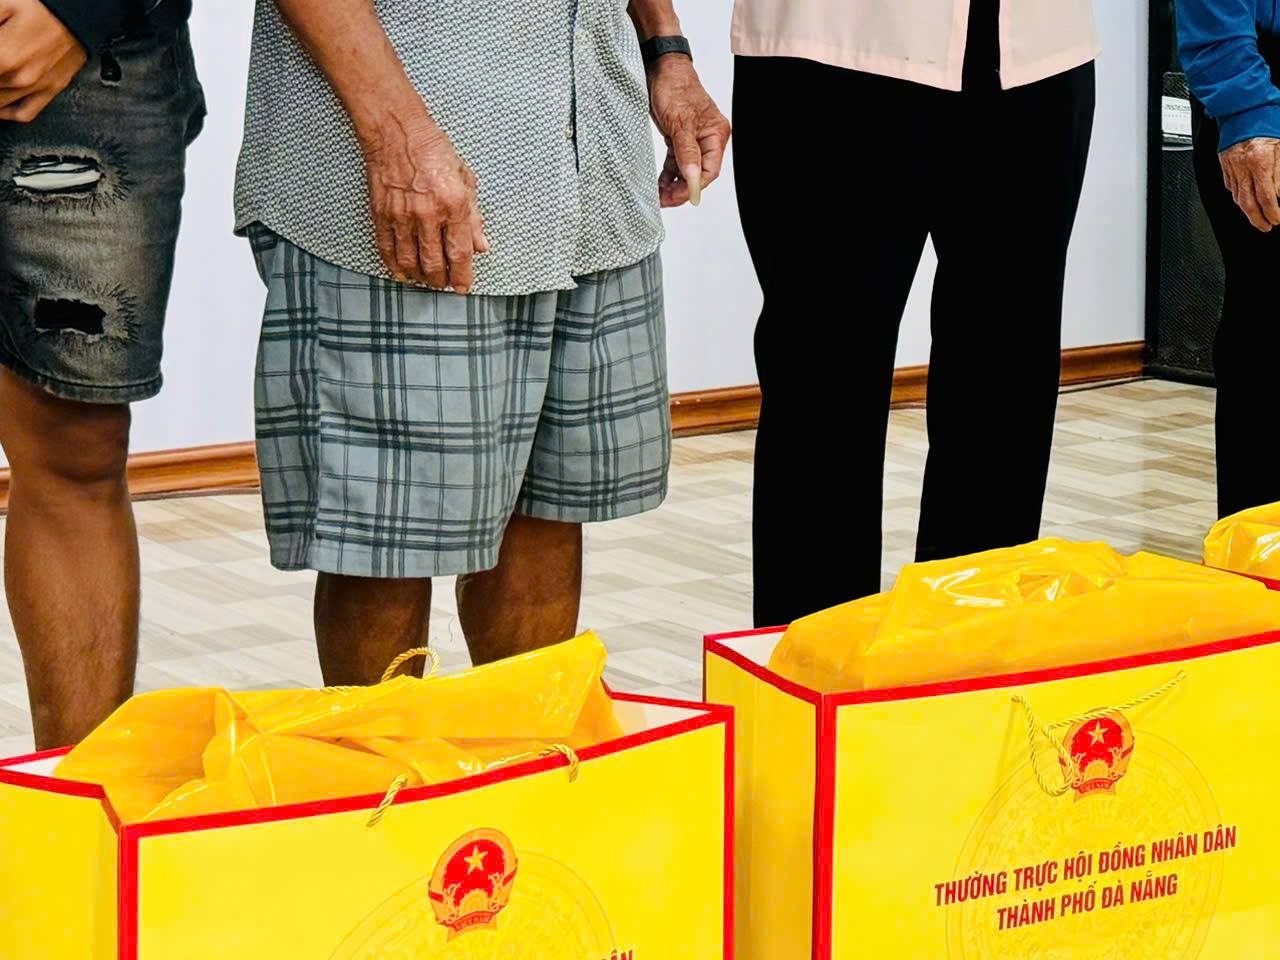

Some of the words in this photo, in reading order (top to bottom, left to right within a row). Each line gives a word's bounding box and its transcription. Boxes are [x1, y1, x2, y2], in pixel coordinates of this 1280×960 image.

[934, 871, 1007, 906] THƯỜNG
[1013, 858, 1058, 892] TRỰC
[1063, 851, 1092, 884] HỘI
[1098, 841, 1146, 875] ĐỒNG
[1151, 832, 1197, 864] NHÂN
[1202, 824, 1237, 858] DÂN
[997, 900, 1055, 931] THÀNH
[1060, 880, 1097, 917] PHỐ
[1101, 881, 1124, 908] ĐÀ
[1130, 870, 1178, 904] NẴNG
